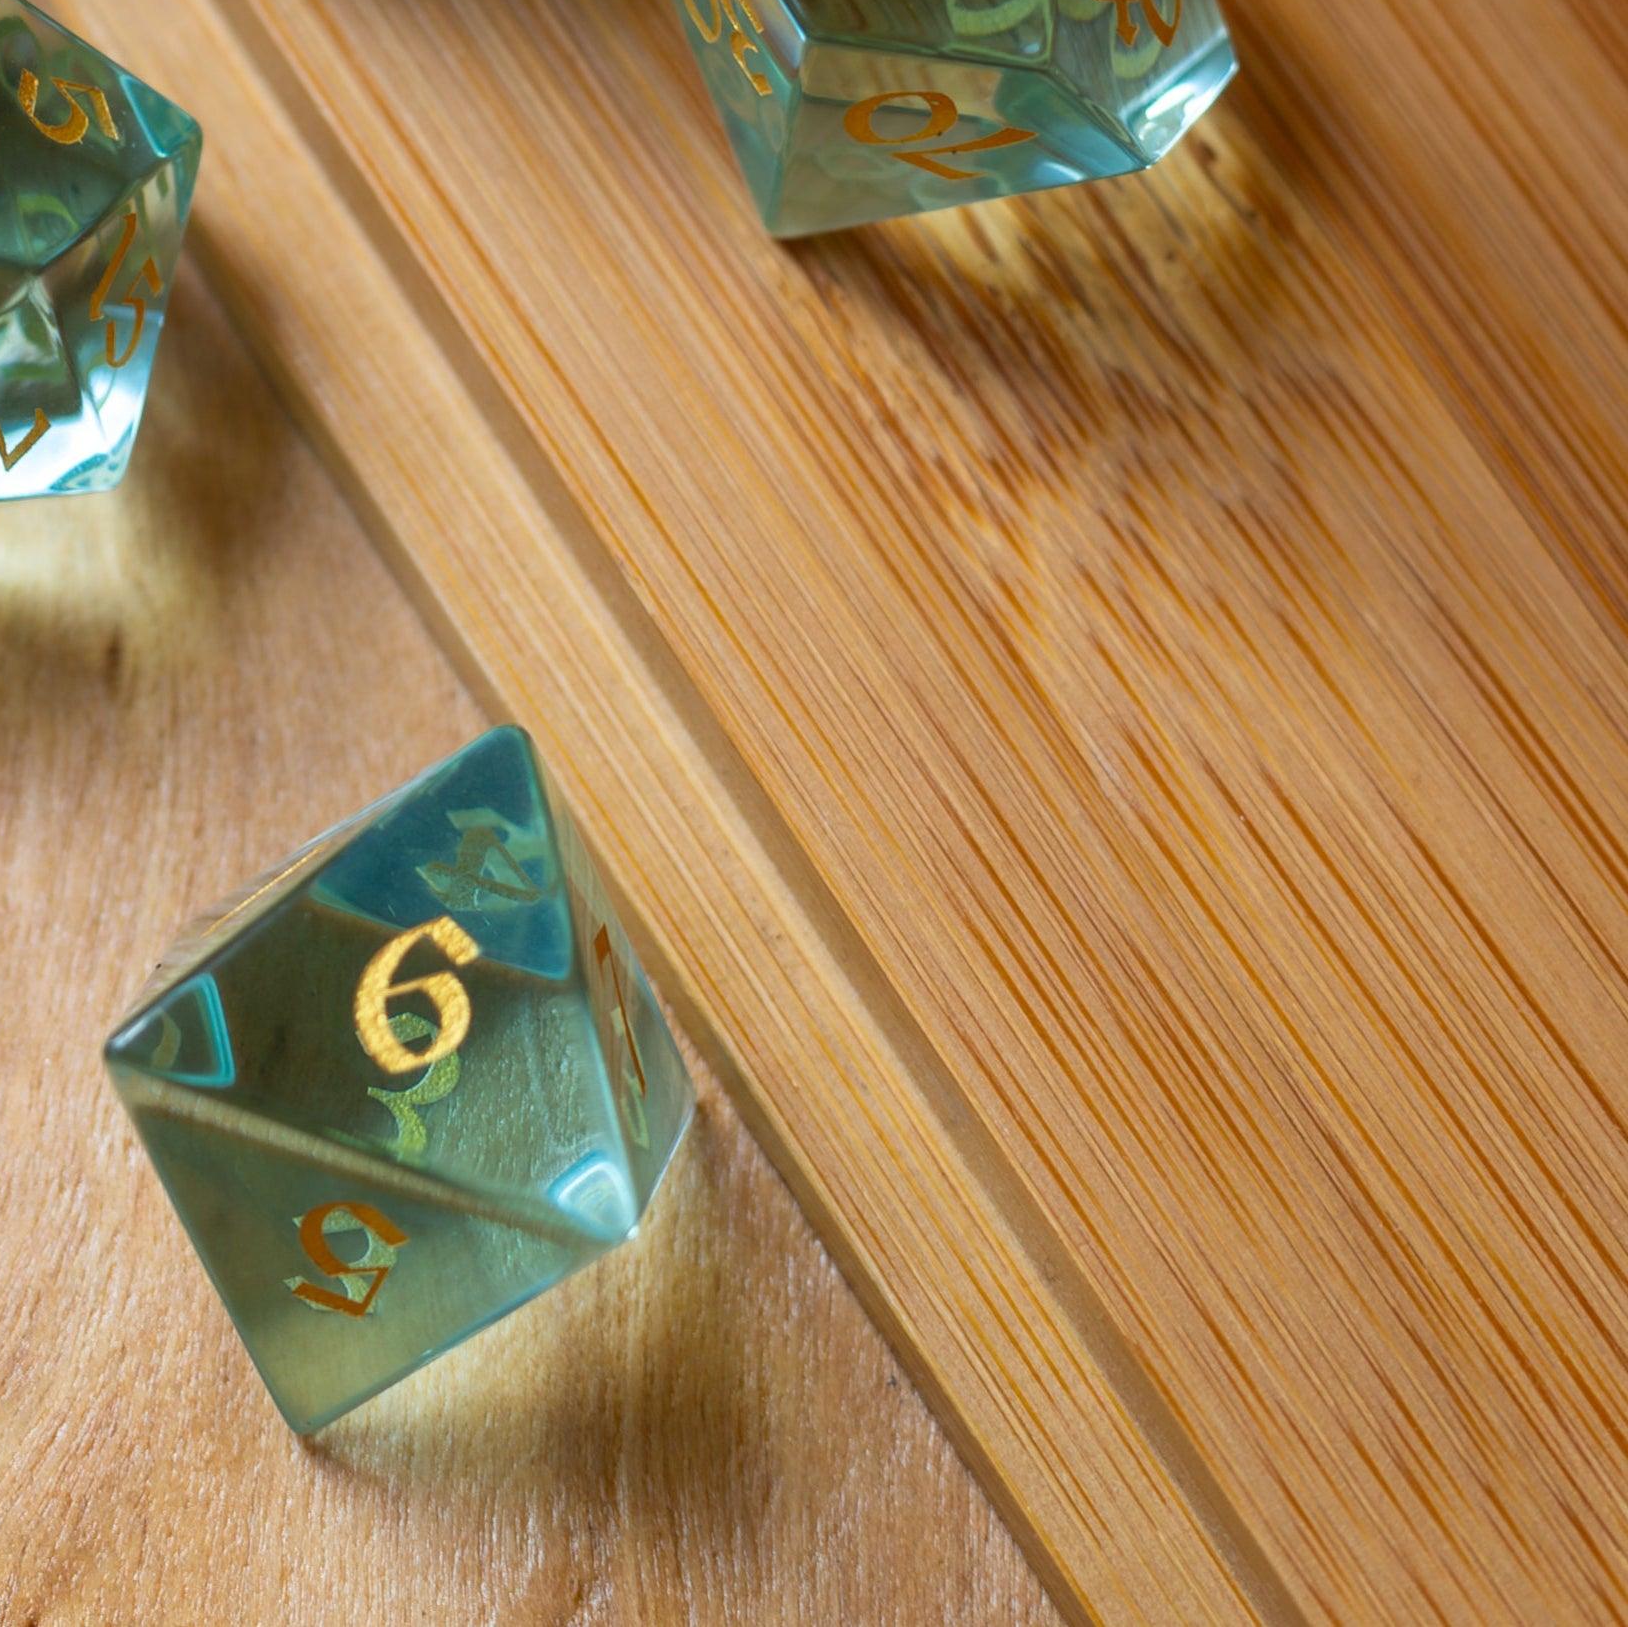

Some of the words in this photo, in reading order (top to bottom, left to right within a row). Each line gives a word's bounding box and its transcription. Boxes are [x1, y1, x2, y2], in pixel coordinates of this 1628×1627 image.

[18, 68, 120, 145] 5
[843, 90, 1039, 181] 70
[353, 915, 481, 1074] 6
[292, 1201, 410, 1318] 5
